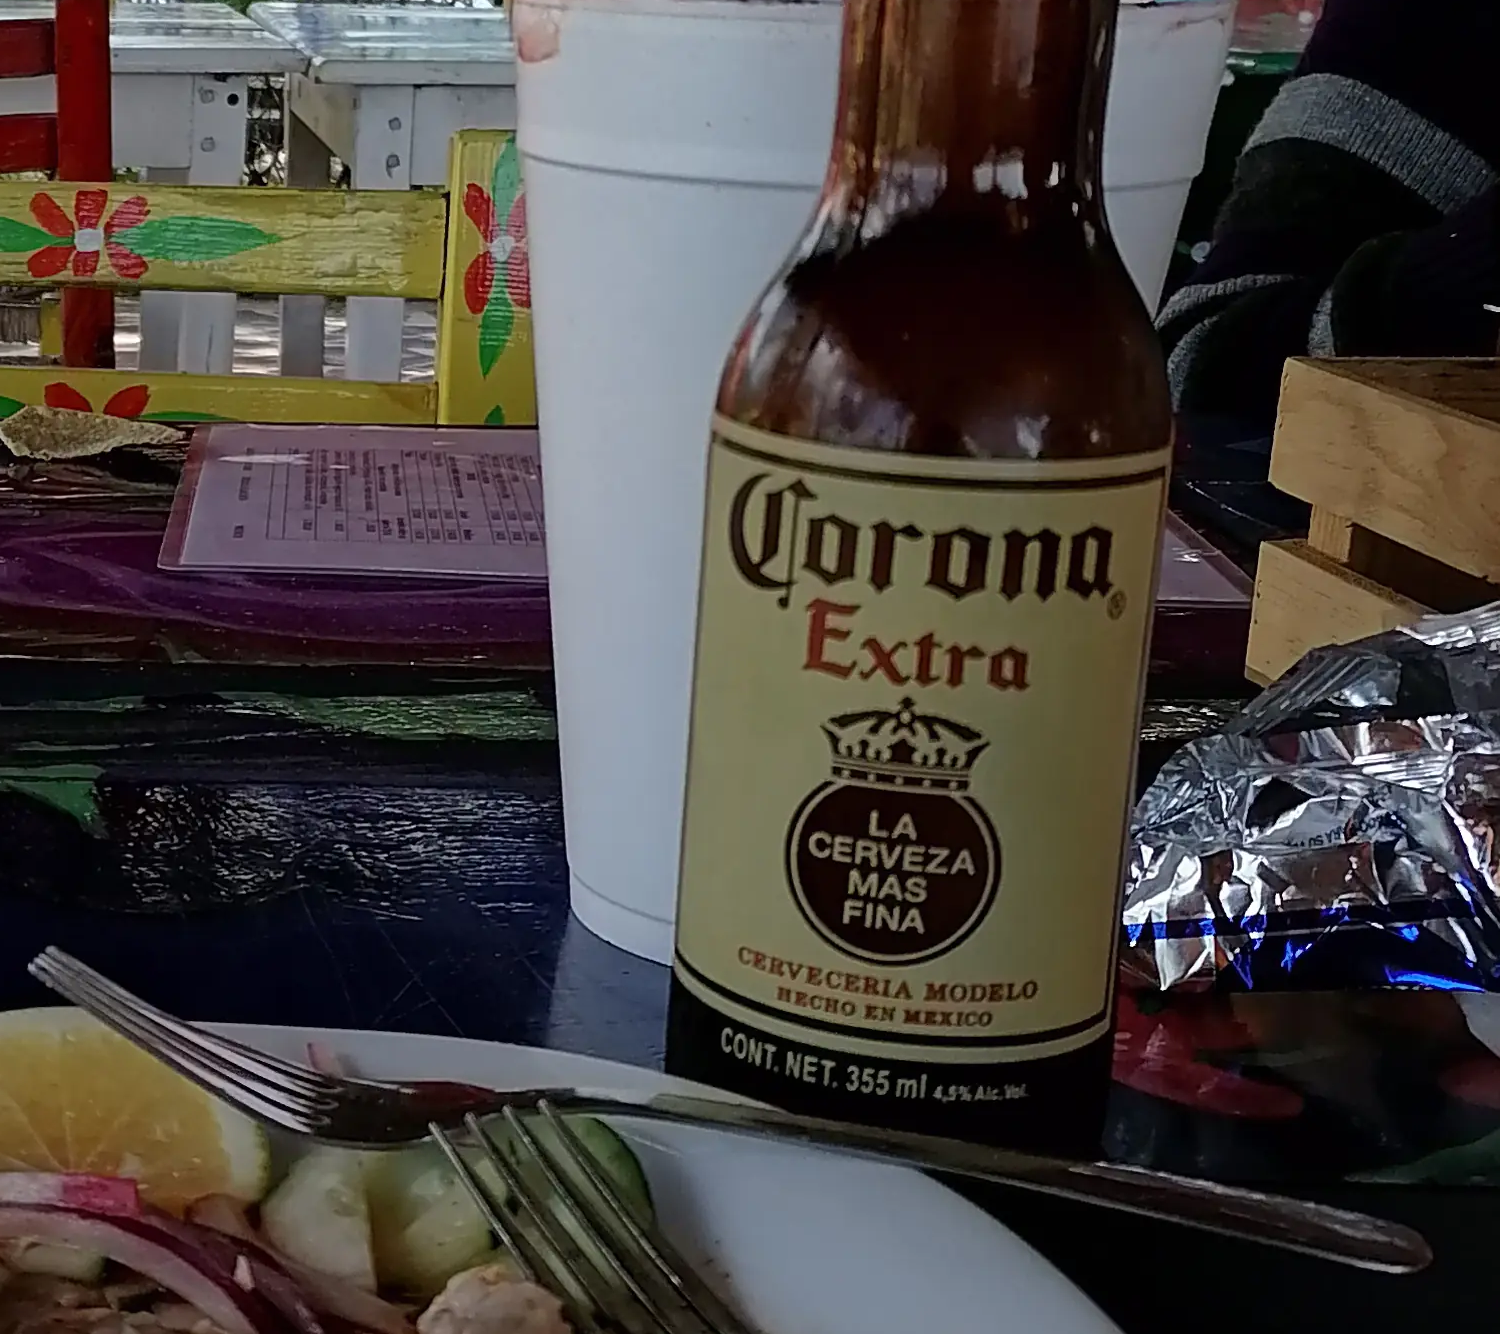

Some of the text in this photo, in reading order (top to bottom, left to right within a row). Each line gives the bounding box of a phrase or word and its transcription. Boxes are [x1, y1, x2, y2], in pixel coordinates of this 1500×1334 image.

[729, 472, 1114, 608] Corona
[802, 598, 1030, 691] Extra
[868, 811, 918, 842] LA
[808, 831, 976, 877] CERVEZA
[847, 868, 929, 904] MAS
[841, 899, 927, 935] FINA
[738, 945, 1039, 1003] CERVECERIA MODELO
[777, 986, 994, 1028] HECHO EN MEXICO
[721, 1026, 781, 1073] CONT.
[785, 1050, 838, 1089] NET.
[845, 1065, 890, 1096] 355
[896, 1074, 928, 1099] ml
